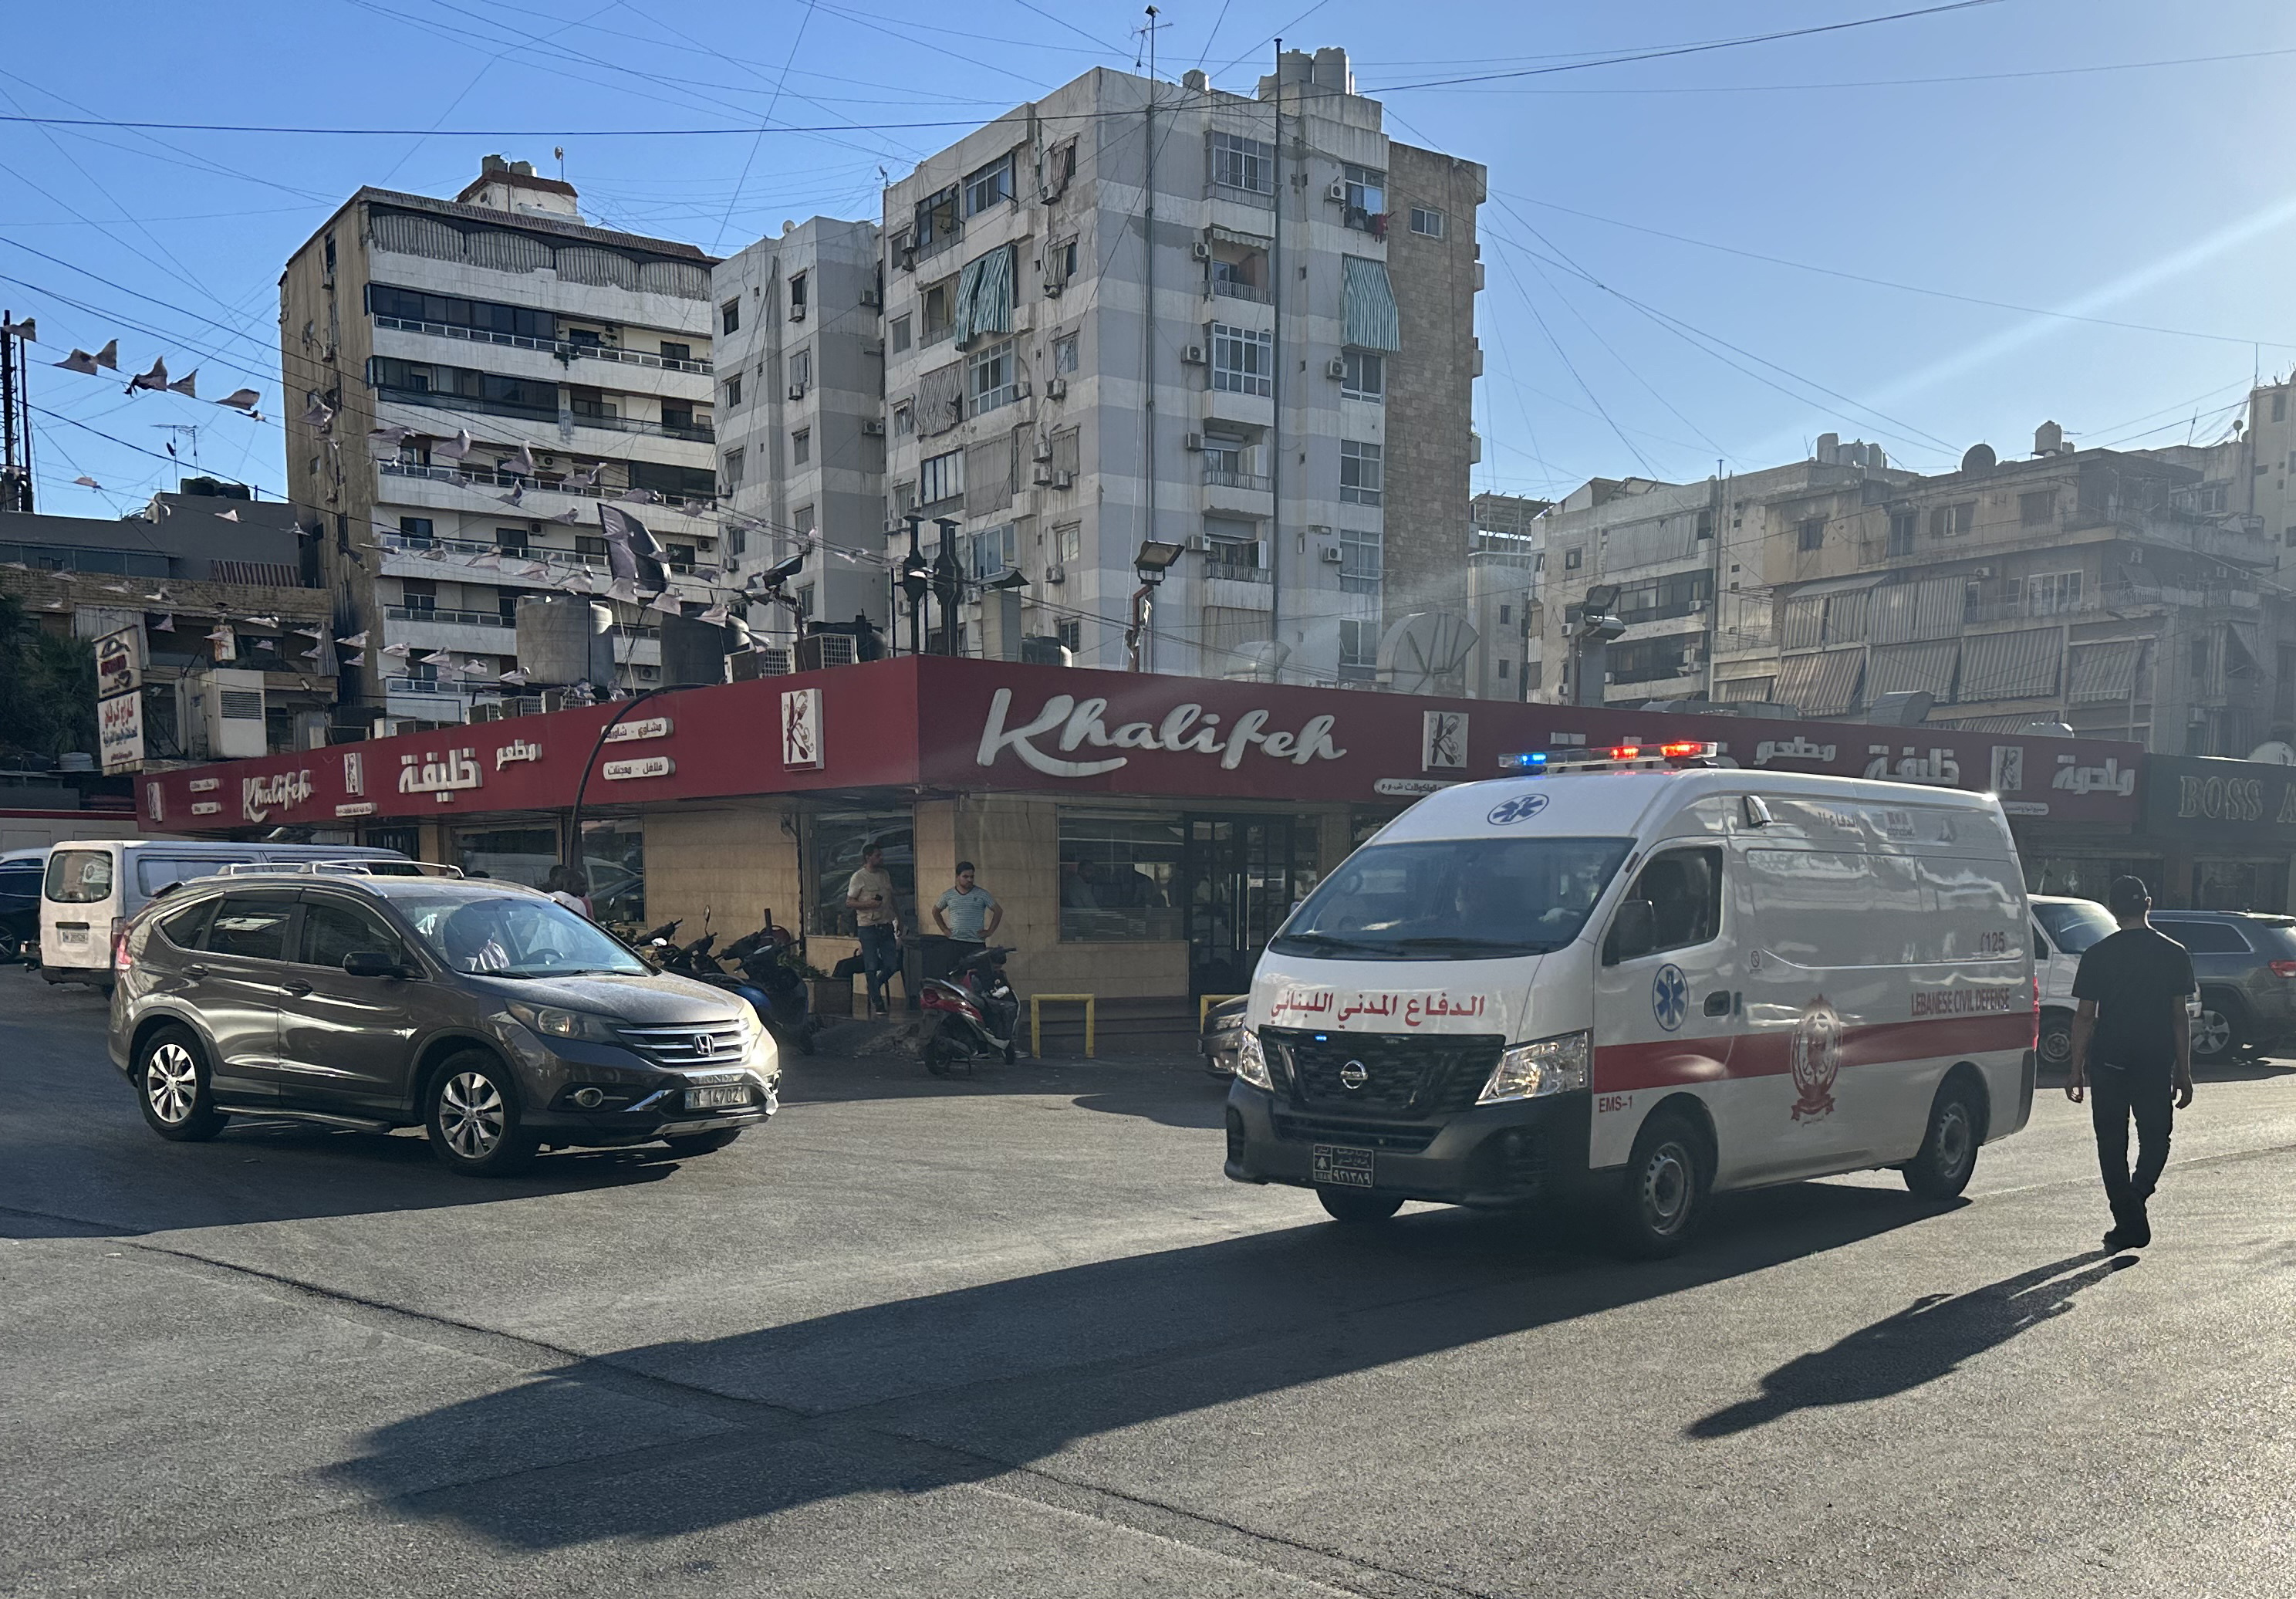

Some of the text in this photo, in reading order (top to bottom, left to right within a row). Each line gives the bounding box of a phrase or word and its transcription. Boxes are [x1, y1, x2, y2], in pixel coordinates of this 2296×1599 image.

[976, 688, 1346, 777] Khalifeh
[1752, 736, 1836, 766] مطعم
[399, 739, 541, 802] مطعم خليفة
[243, 769, 314, 823] Khalifeh
[2177, 776, 2264, 821] BOSS
[1271, 991, 1485, 1029] الدفاع المدني اللبناني
[1911, 987, 2010, 1016] LEBANESE CIVIL DEFENSE
[1599, 1094, 1633, 1113] EMS-1
